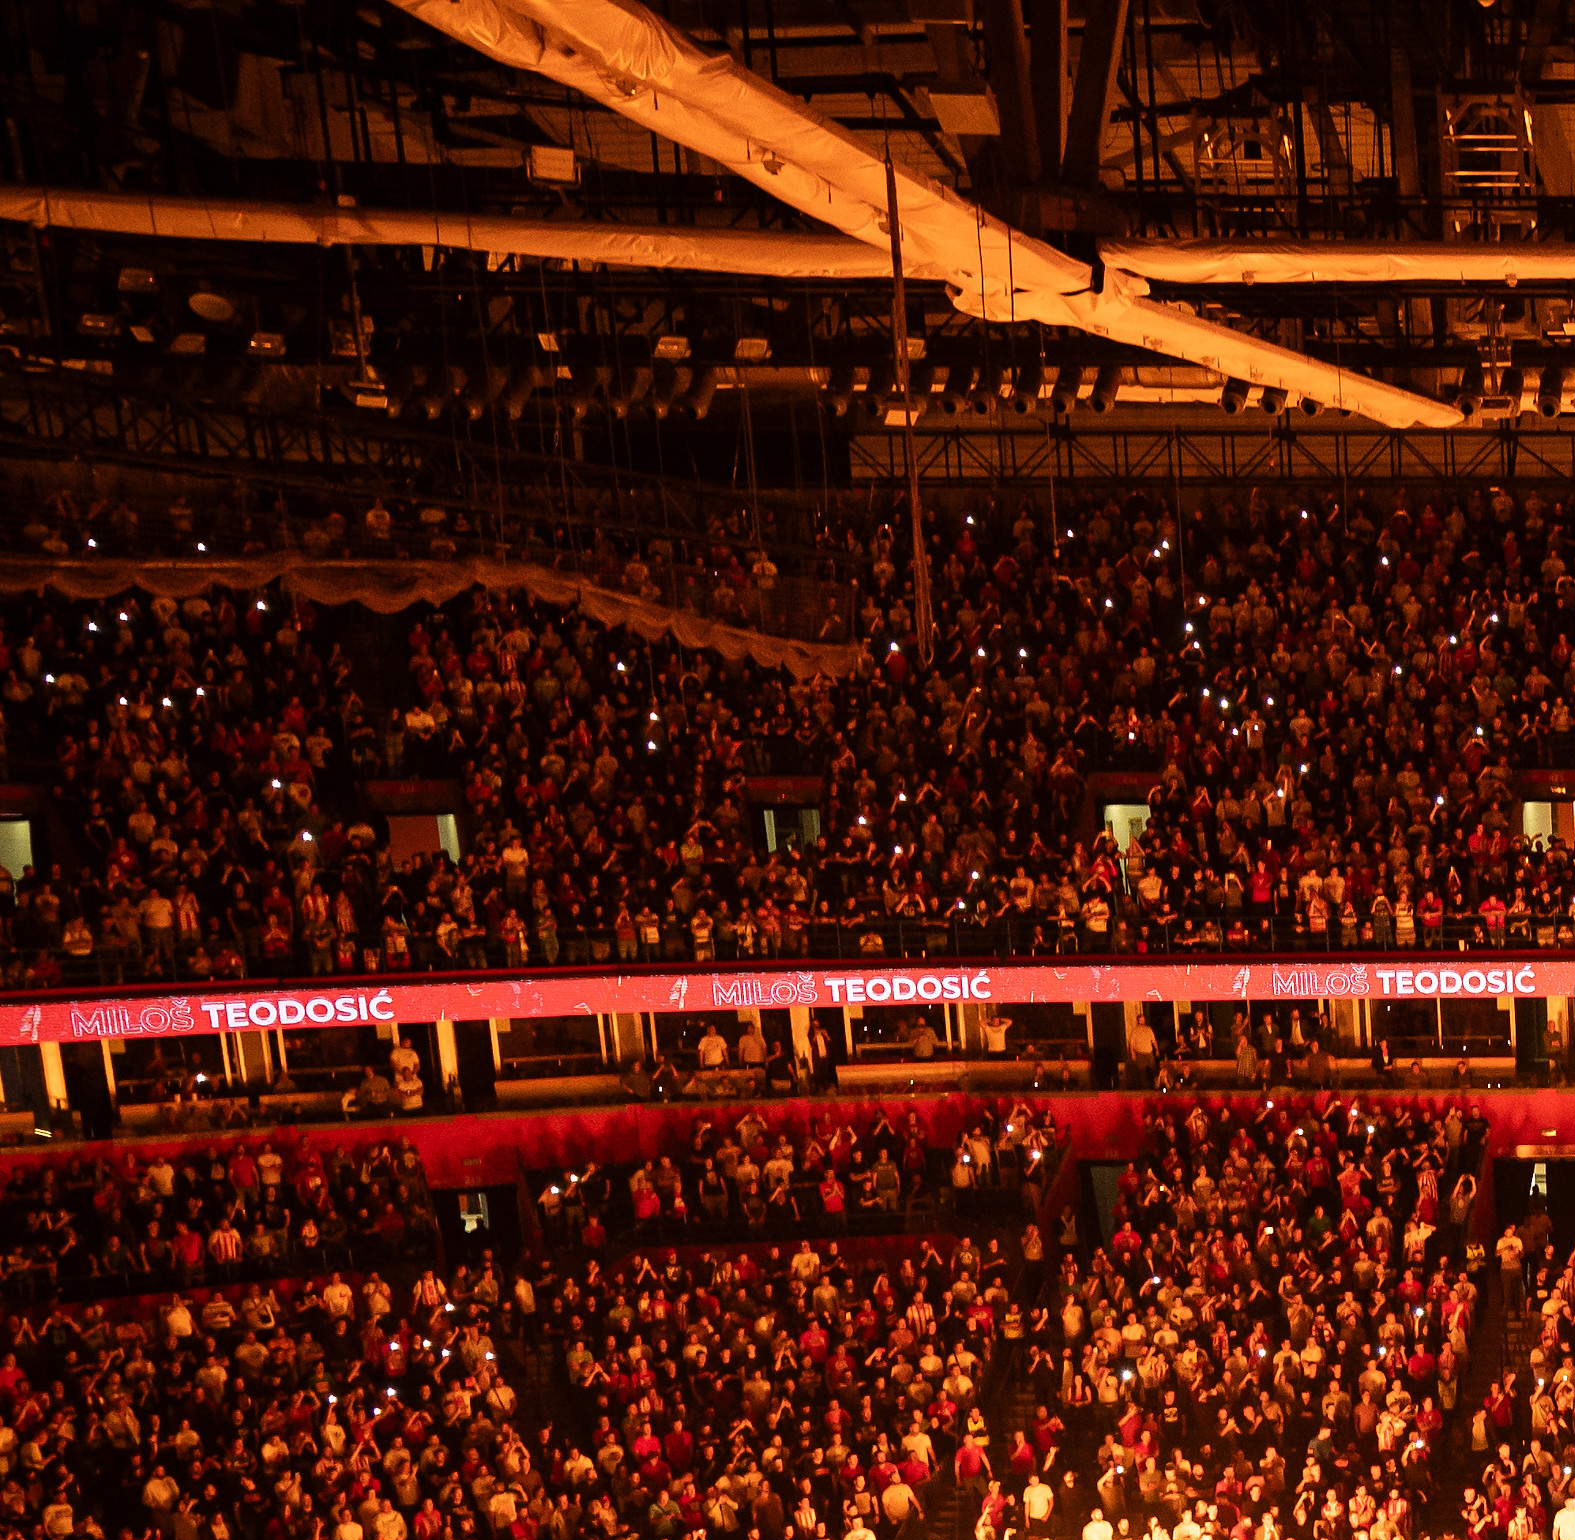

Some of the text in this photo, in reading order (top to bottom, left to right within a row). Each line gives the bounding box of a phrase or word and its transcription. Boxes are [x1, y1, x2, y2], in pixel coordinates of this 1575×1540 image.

[713, 971, 818, 1006] MILOŠ
[824, 970, 992, 1003] TEODOSIĆ
[1273, 963, 1371, 996] MILOŠ
[1376, 964, 1536, 995] TEODOSIĆ
[73, 997, 194, 1038] MILOŠ
[202, 989, 396, 1030] TEODOSIĆ
